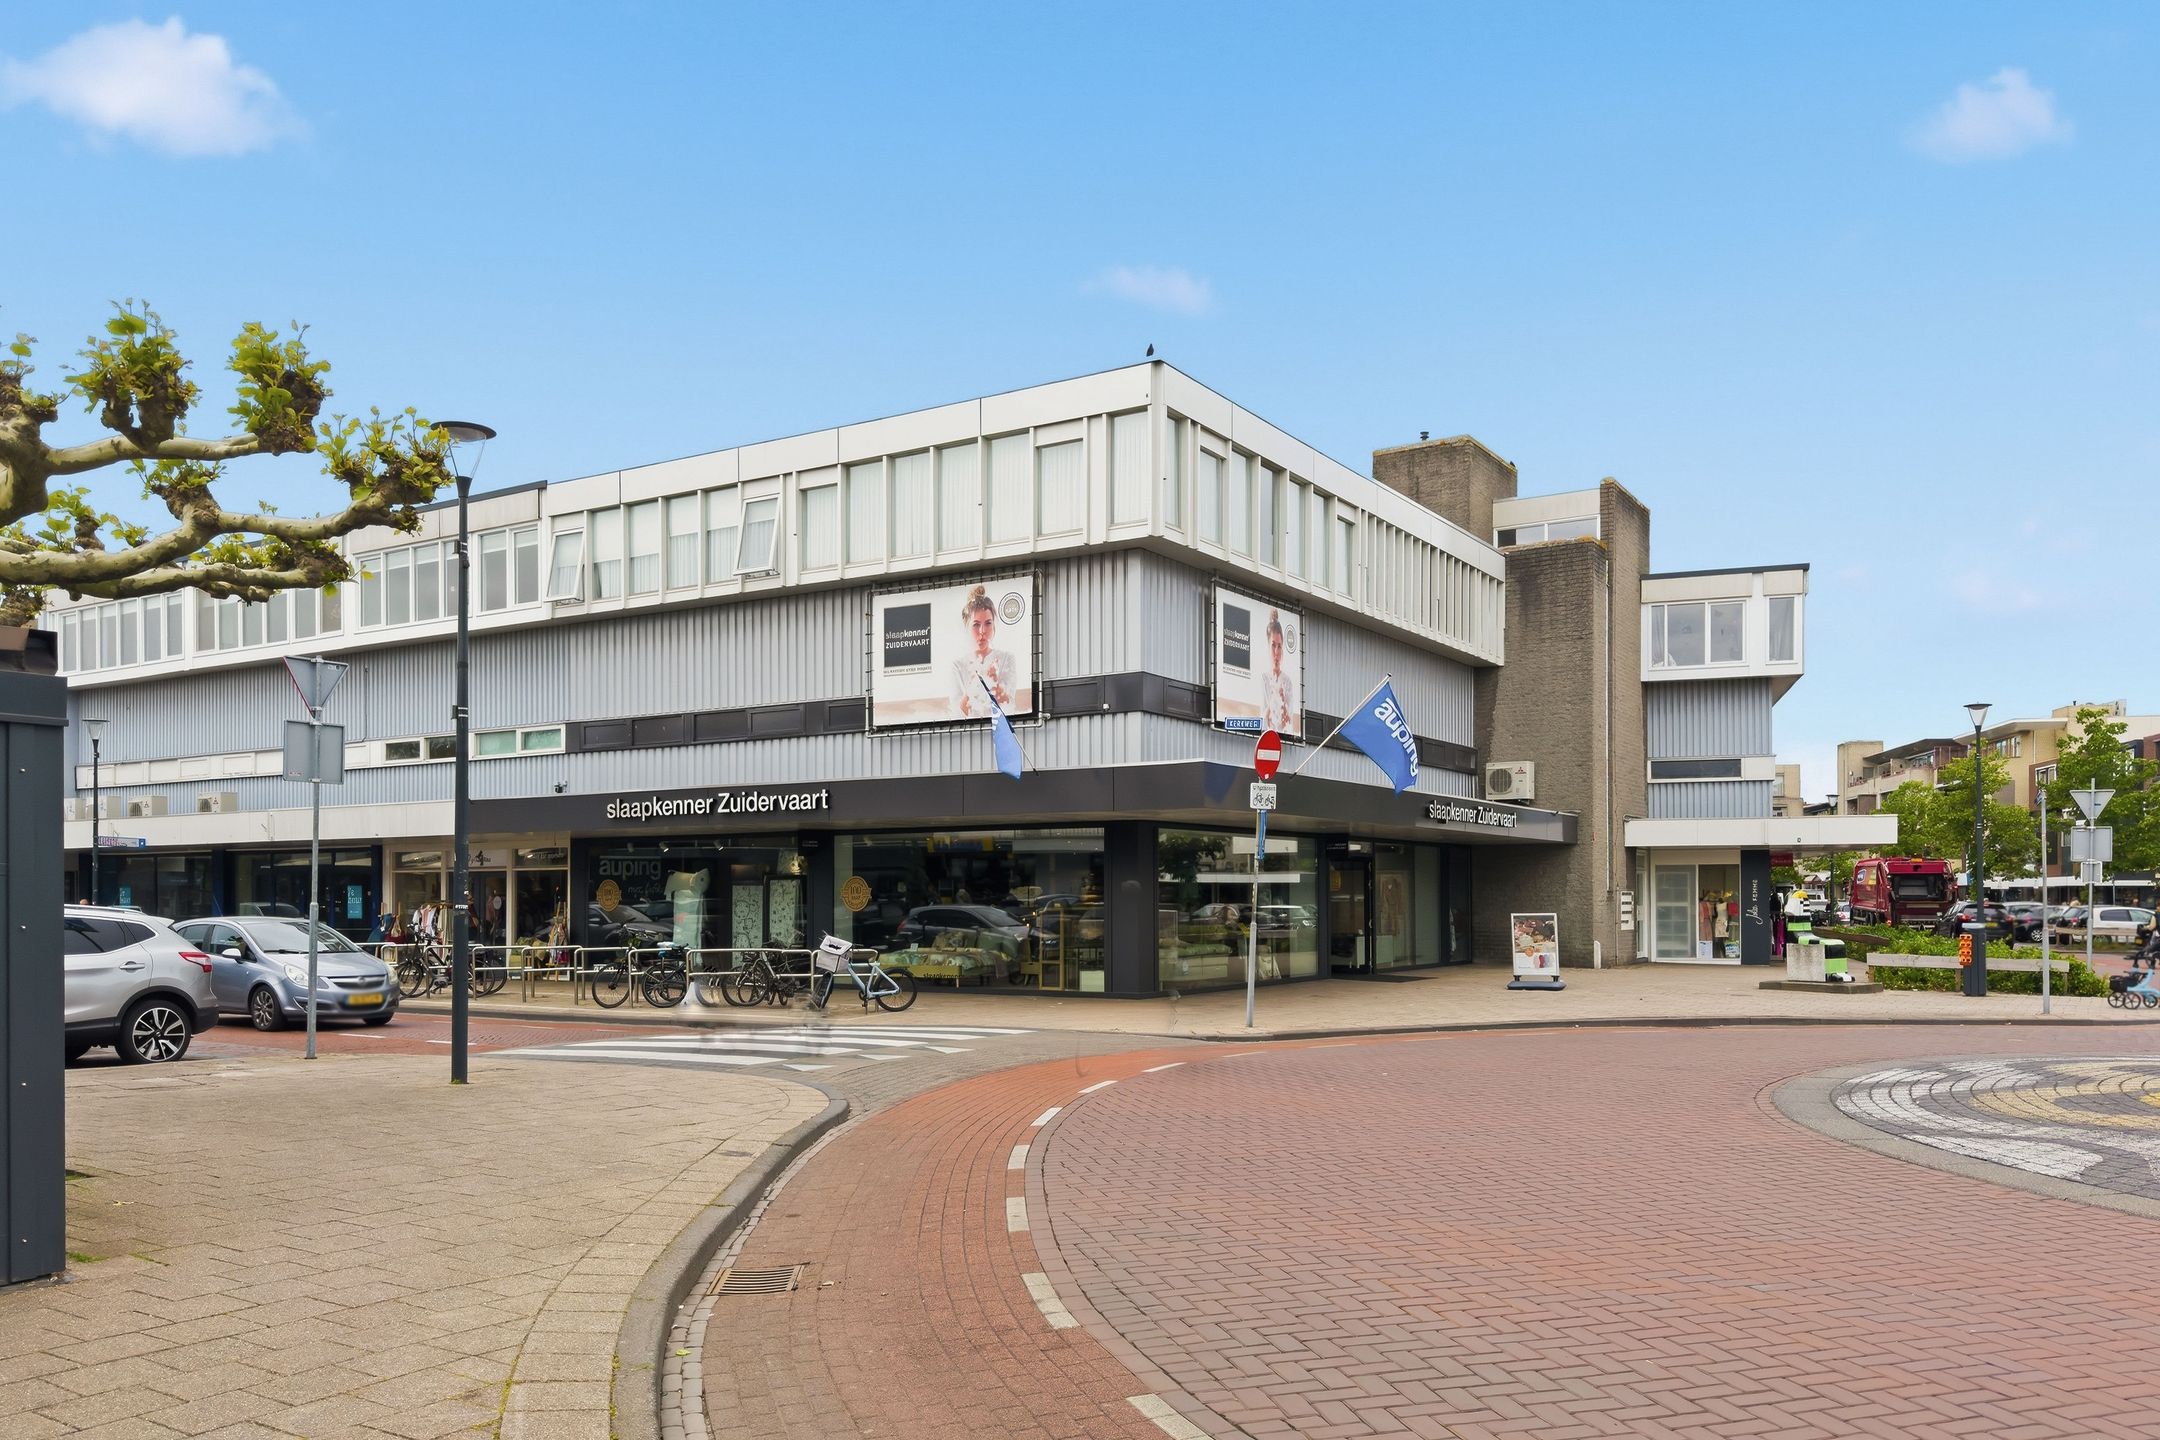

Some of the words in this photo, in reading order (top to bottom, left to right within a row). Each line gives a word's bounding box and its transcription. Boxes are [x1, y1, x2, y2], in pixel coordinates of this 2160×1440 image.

[886, 638, 930, 649] ZUIDERVAART
[1374, 699, 1418, 777] auping
[607, 796, 713, 821] slaapkenner
[717, 789, 829, 814] Zuidervaart
[1429, 800, 1477, 824] slaapkenner
[1478, 806, 1517, 828] Zuidervaart
[599, 856, 661, 880] auping
